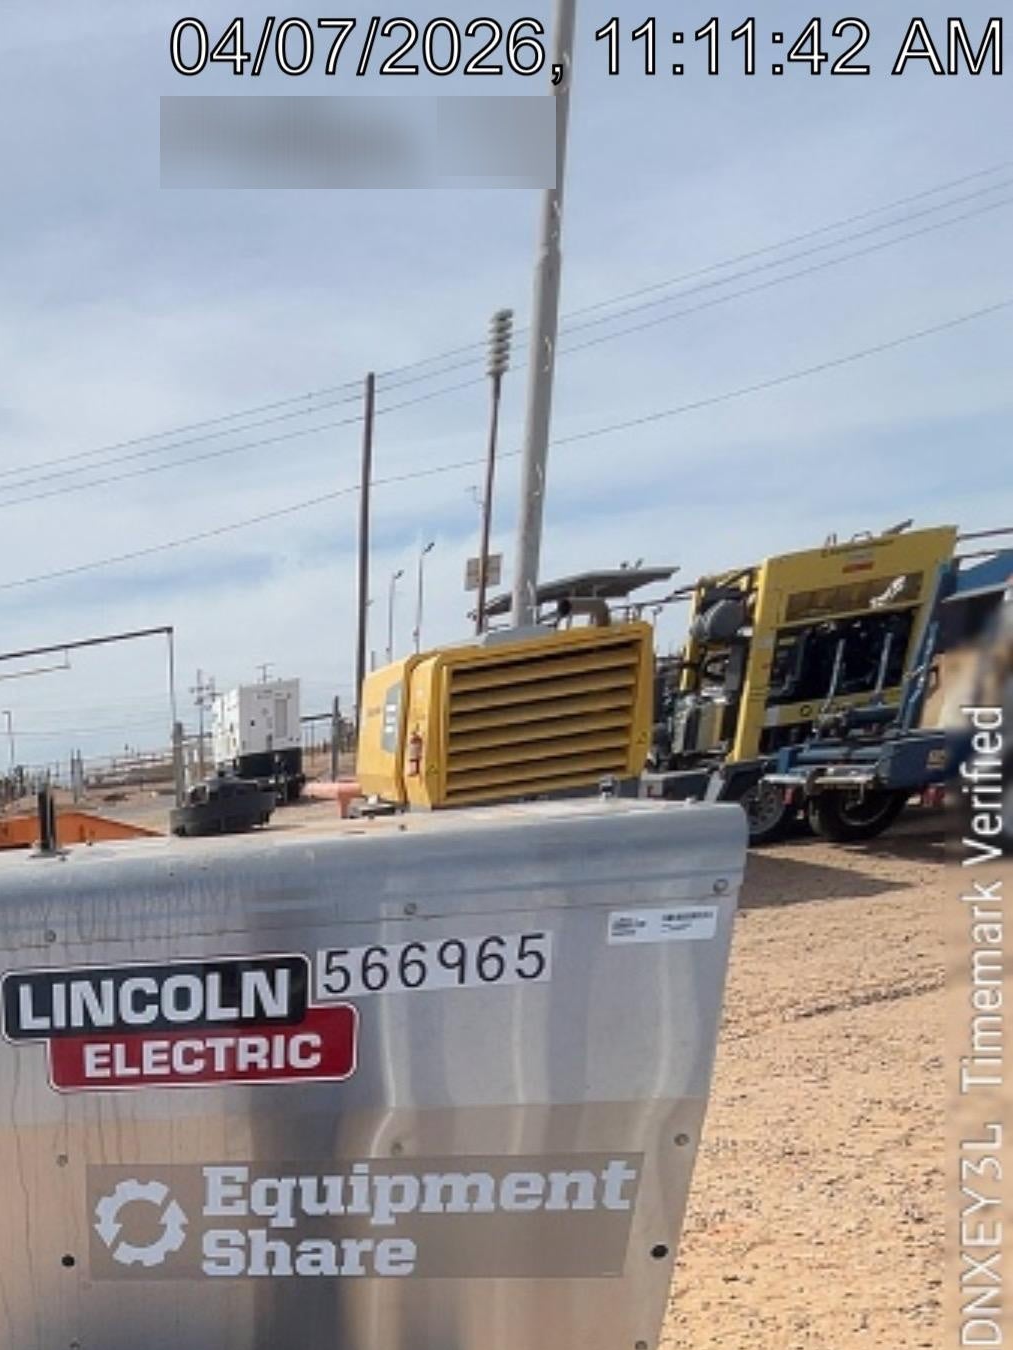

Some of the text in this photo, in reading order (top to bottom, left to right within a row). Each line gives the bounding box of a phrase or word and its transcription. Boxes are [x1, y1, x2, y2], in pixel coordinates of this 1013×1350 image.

[322, 932, 547, 996] 566965
[17, 965, 290, 1031] LINCOLN
[82, 1032, 324, 1080] ELECTRIC
[201, 1159, 637, 1227] Equipment
[201, 1229, 418, 1278] Share
